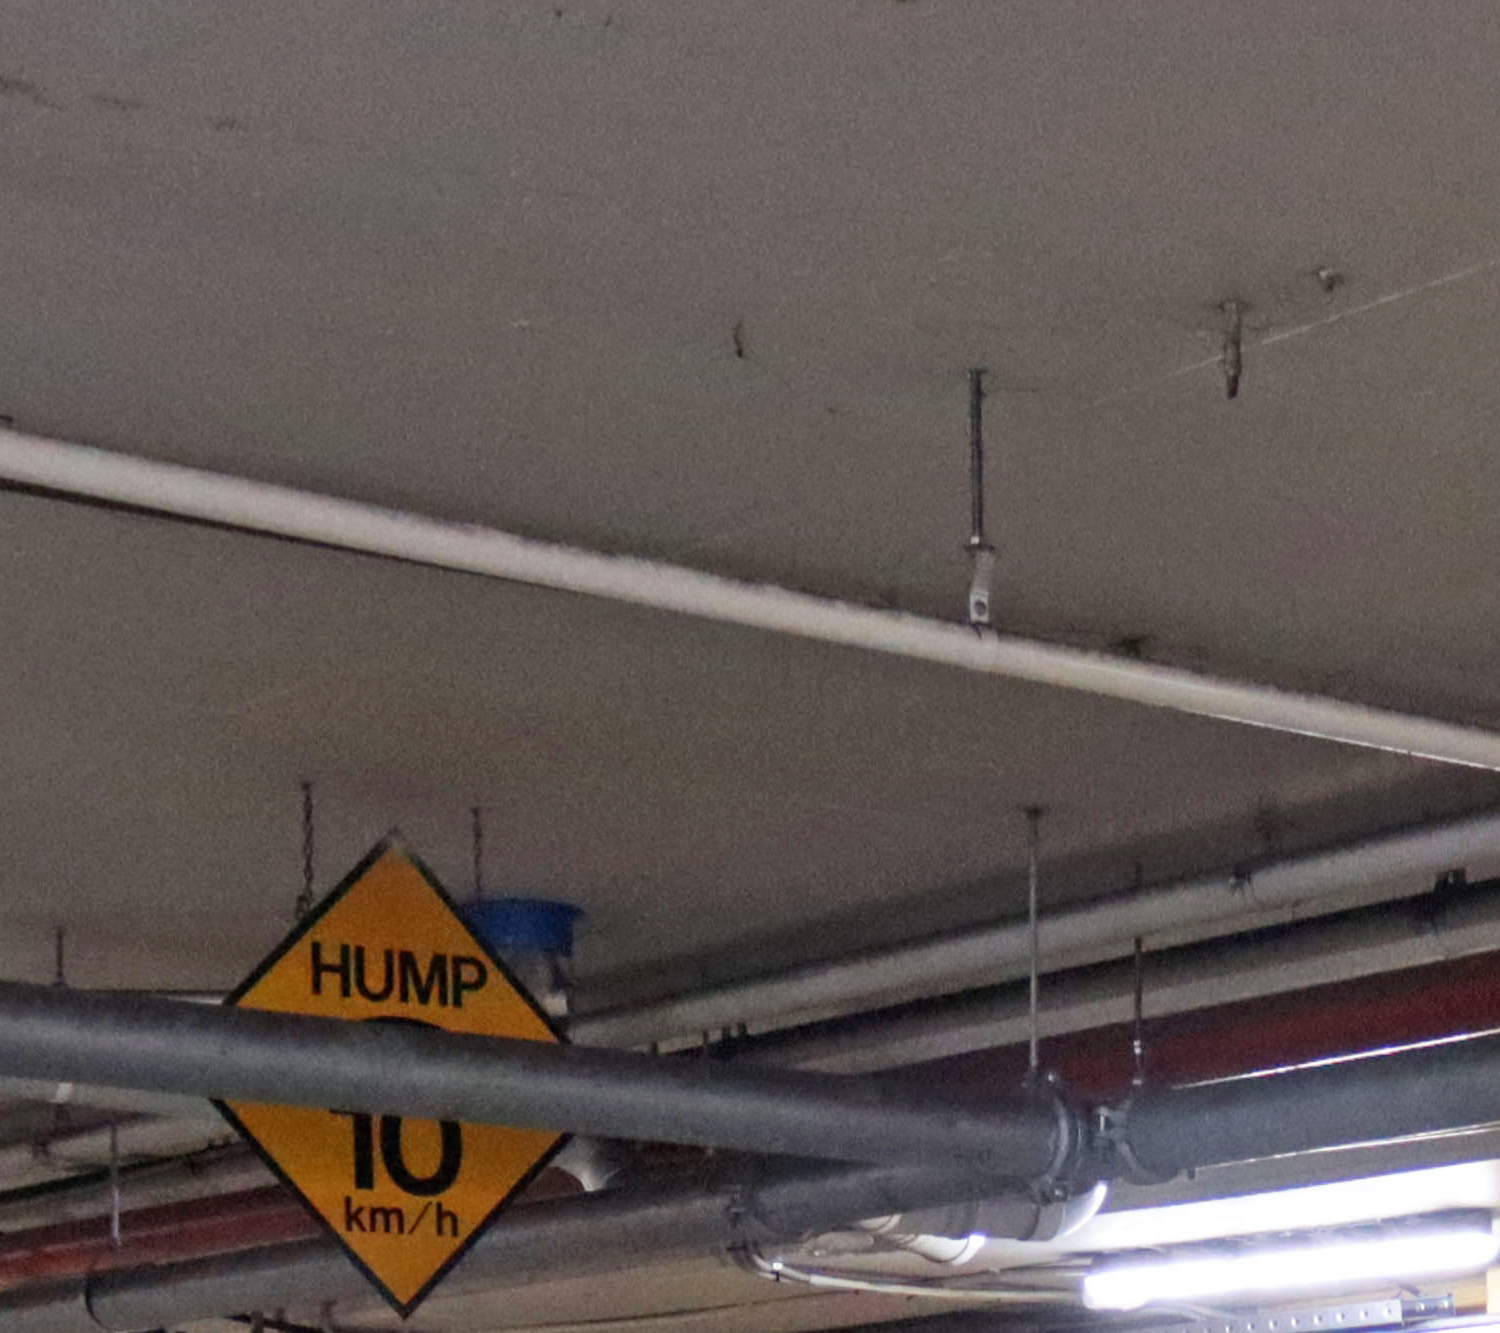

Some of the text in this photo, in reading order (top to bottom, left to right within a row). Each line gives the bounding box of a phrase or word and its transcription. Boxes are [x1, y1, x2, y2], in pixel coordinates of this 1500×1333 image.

[310, 941, 489, 1009] HUMP
[329, 1106, 464, 1198] 10
[344, 1195, 459, 1238] km/h
